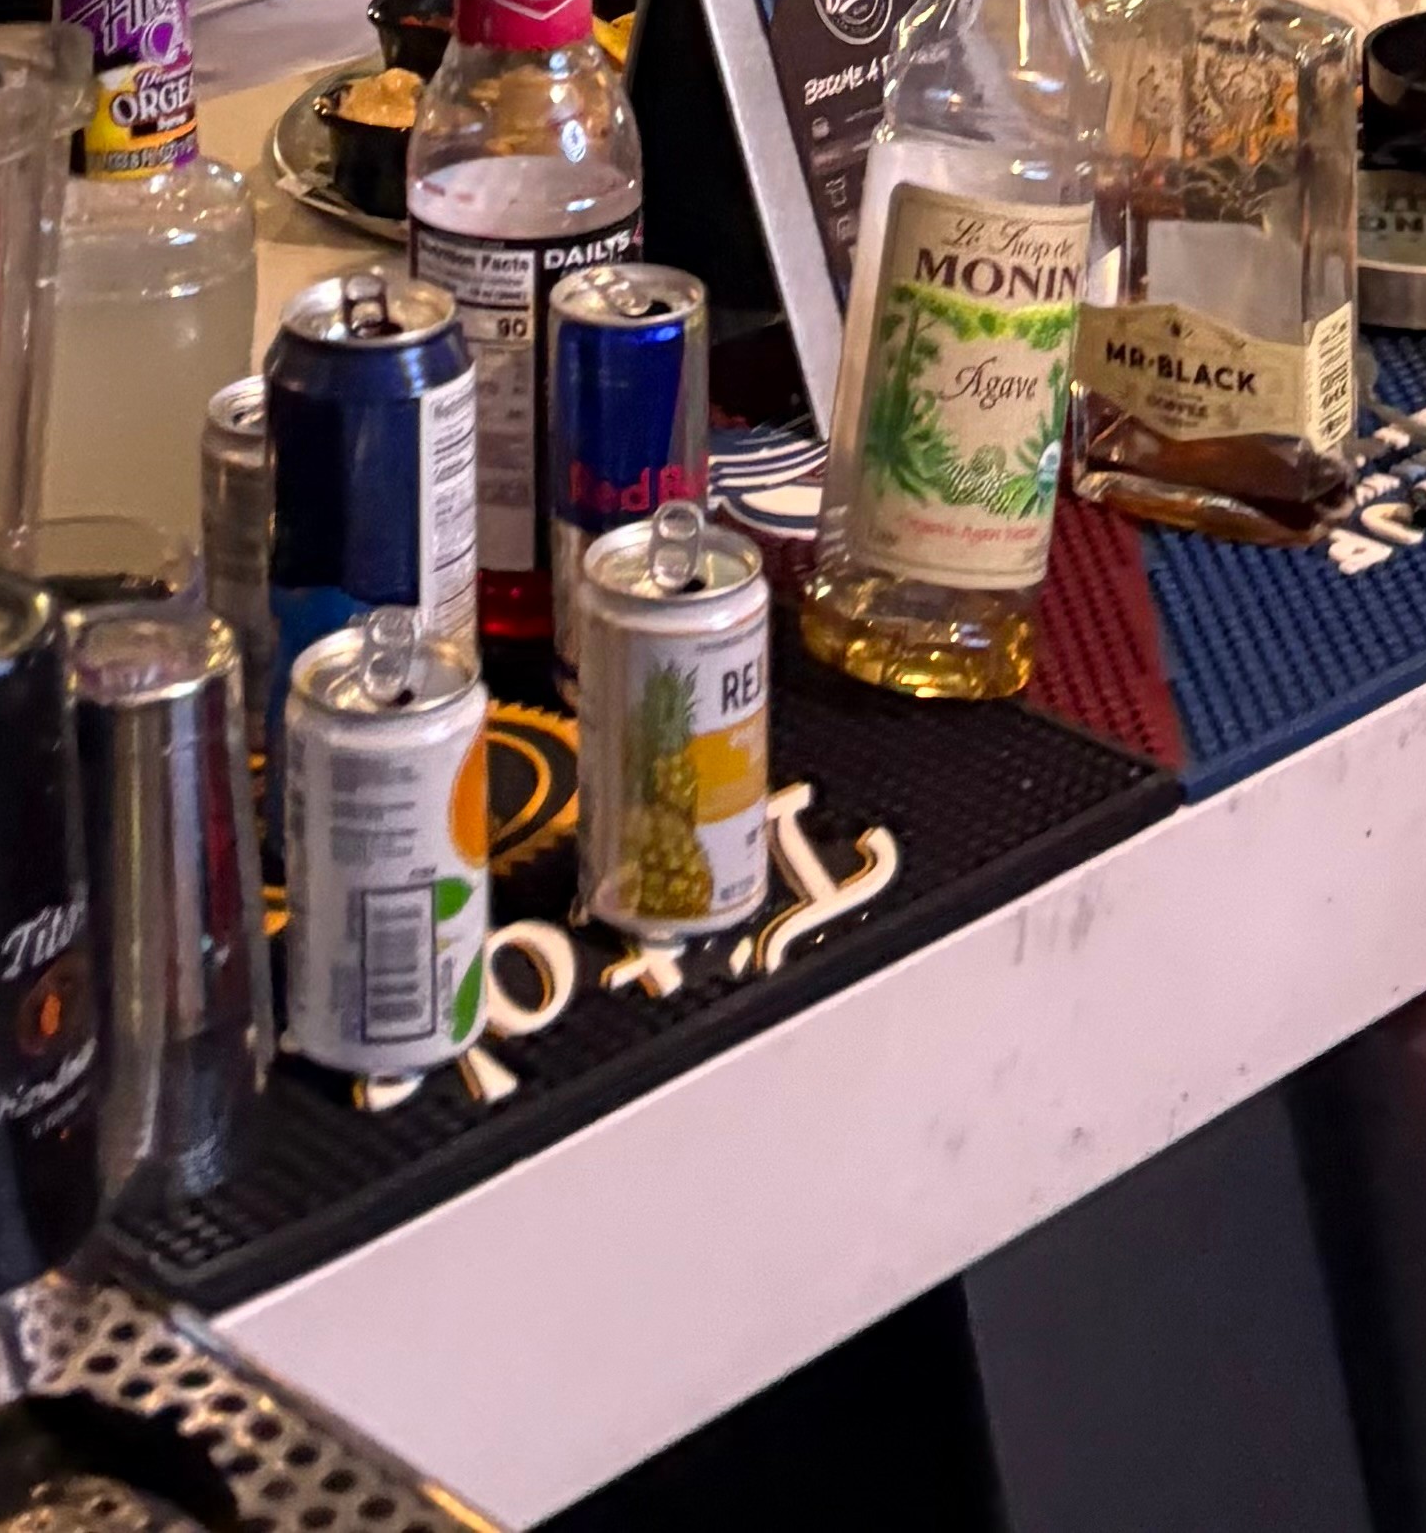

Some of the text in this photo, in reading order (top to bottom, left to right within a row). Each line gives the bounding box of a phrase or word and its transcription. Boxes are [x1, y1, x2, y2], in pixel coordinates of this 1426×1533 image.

[805, 64, 864, 106] BECOME
[915, 247, 1084, 301] MONIN
[497, 316, 528, 339] 90
[937, 355, 1039, 410] Agave
